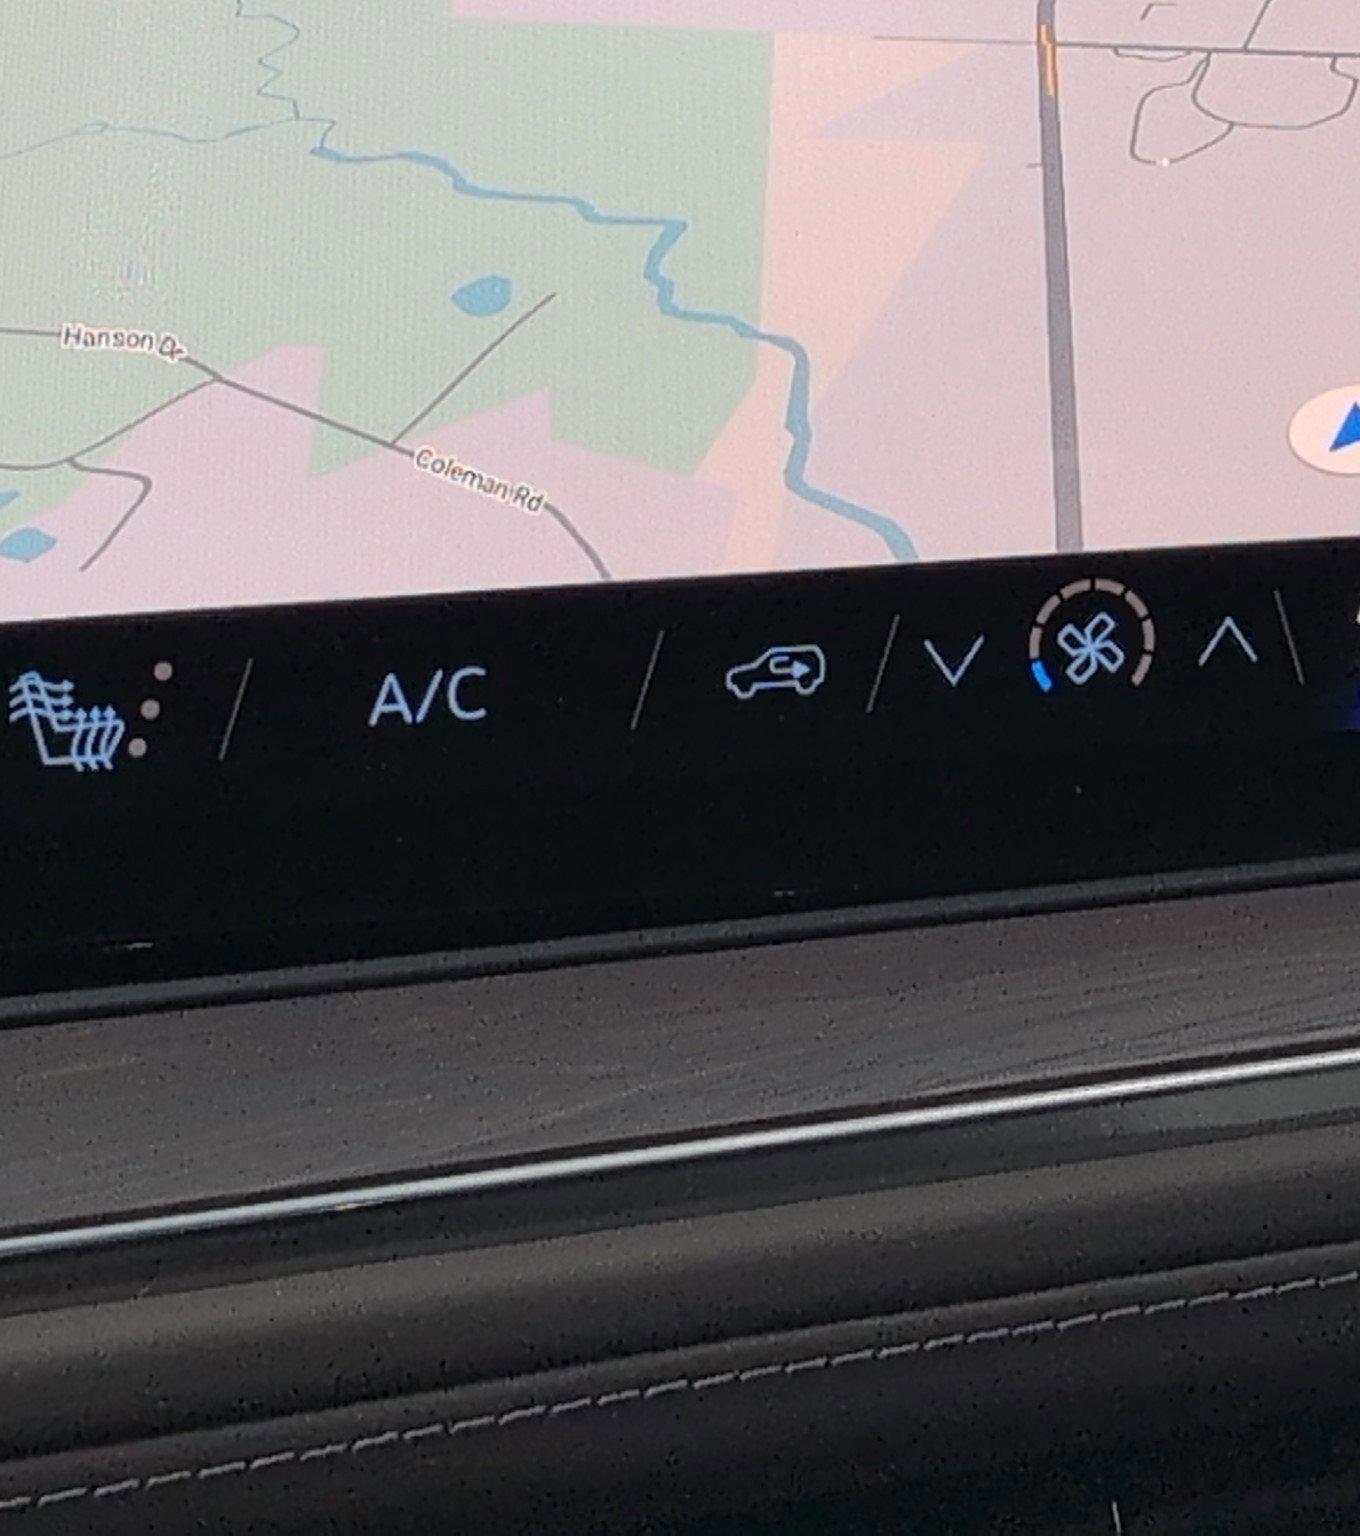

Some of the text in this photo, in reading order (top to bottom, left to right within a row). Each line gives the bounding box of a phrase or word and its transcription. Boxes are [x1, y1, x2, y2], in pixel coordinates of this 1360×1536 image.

[62, 325, 185, 360] Hanson Dr
[414, 448, 544, 513] Coleman Rd
[368, 667, 488, 729] A/C
